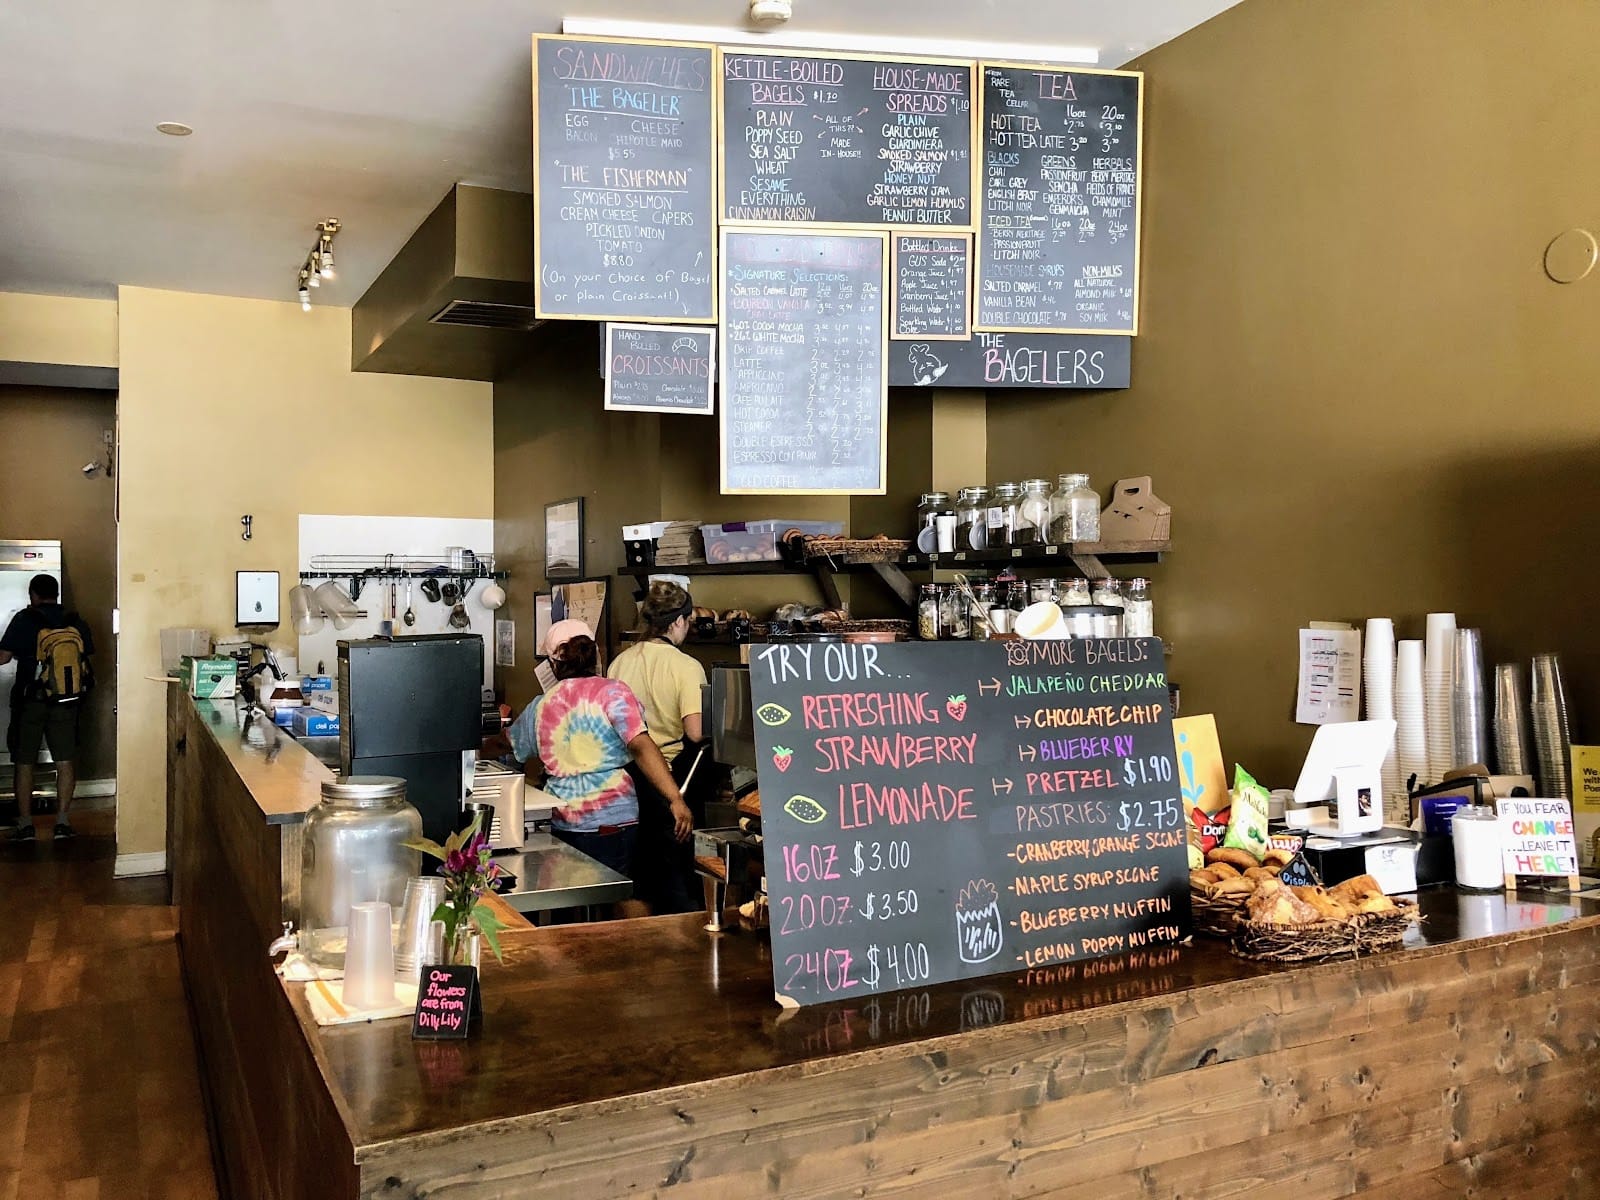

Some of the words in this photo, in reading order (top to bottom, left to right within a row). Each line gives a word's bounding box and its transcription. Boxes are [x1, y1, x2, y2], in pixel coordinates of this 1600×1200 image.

[553, 47, 706, 91] SANDWICHES
[725, 57, 844, 85] KETTLE-BOILED
[873, 66, 964, 92] HOUSE-MADE
[991, 77, 1010, 87] RARE
[751, 82, 805, 104] BAGELS
[999, 88, 1015, 98] TEA
[1032, 73, 1078, 101] TEA
[568, 87, 604, 108] THE
[612, 87, 682, 115] BAGELER
[886, 92, 947, 113] SPREADS
[566, 113, 588, 127] EGG
[756, 110, 793, 127] PLAIN
[825, 114, 839, 124] ALL
[897, 113, 927, 126] PLAIN
[991, 113, 1015, 131] HOT
[1017, 115, 1041, 132] TEA
[631, 120, 680, 135] CHEESE
[881, 124, 913, 138] GARLIC
[913, 126, 940, 139] CHIVE
[745, 126, 773, 143] POPPY
[777, 128, 803, 145] SEED
[831, 137, 851, 148] MADE
[989, 130, 1015, 146] HOT
[1015, 132, 1038, 149] TEA
[1039, 135, 1066, 149] LATTE
[749, 144, 769, 159] SEA
[774, 145, 799, 160] SALT
[877, 148, 912, 160] SMOKED
[914, 150, 948, 162] SALMON
[987, 151, 1020, 165] BLACKS
[755, 160, 789, 175] WHEAT
[887, 161, 942, 174] STRAWBERRY
[1041, 155, 1076, 168] GREENS
[1093, 157, 1133, 170] HERBALS
[884, 172, 913, 184] HONEY
[917, 173, 937, 185] NUT
[988, 166, 1006, 177] CHAI
[1040, 169, 1088, 182] PASSIONFRUIT
[1090, 171, 1108, 183] BERRY
[750, 176, 792, 192] SESAME
[873, 183, 928, 196] STRAWBERRY
[931, 185, 951, 196] JAM
[1008, 177, 1029, 189] GREY
[573, 191, 621, 206] SMOKED
[626, 194, 672, 211] SALMON
[741, 191, 806, 206] EVERYTHING
[867, 194, 898, 207] GARLIC
[901, 196, 927, 208] LEMON
[930, 197, 966, 210] HUMMUS
[987, 189, 1015, 200] ENGLISH
[1092, 196, 1133, 208] CHAMOMILE
[728, 206, 782, 220] CINNAMON
[785, 206, 816, 221] RAISIN
[1016, 201, 1033, 212] NOIR
[1102, 207, 1125, 218] MINT
[560, 207, 599, 221] CREAM
[602, 208, 638, 222] CHEESE
[652, 212, 694, 226] CAPERS
[882, 207, 914, 222] PEANUT
[917, 209, 952, 224] BUTTER
[987, 215, 1012, 227] ICED
[1014, 215, 1031, 228] TEA
[586, 222, 631, 238] PICKLED
[635, 226, 664, 240] ONION
[596, 239, 642, 252] TOMATO
[901, 238, 929, 253] Bottled
[932, 240, 959, 252] Drinks
[1022, 250, 1041, 261] NOIR
[574, 274, 600, 288] your
[656, 270, 675, 283] of
[681, 271, 710, 285] Bagel
[734, 264, 786, 281] SIGNATURE
[900, 267, 927, 280] Orange
[733, 283, 760, 297] SALTED
[901, 278, 917, 291] Apple
[983, 280, 1011, 293] SALTED
[1013, 282, 1043, 293] CARAMEL
[555, 293, 568, 302] or
[789, 288, 809, 298] LATTE
[1075, 289, 1101, 299] ALMOND
[900, 302, 923, 314] Bottled
[926, 302, 944, 314] Water
[983, 296, 1012, 308] VANILLA
[1015, 295, 1037, 308] BEAN
[1075, 302, 1105, 311] ORGANIC
[981, 311, 1010, 324] DOUBLE
[1013, 311, 1052, 325] CHOCOLATE
[752, 321, 775, 332] COCOA
[777, 323, 804, 333] MOCHA
[630, 341, 660, 351] ROLLED
[752, 332, 779, 344] WHITE
[780, 334, 805, 345] MOCHA
[975, 332, 1005, 348] THE
[612, 354, 709, 378] CROISSANTS
[733, 357, 762, 369] LATTE
[983, 348, 1105, 386] BAGELERS
[1033, 639, 1076, 666] MORE
[1085, 638, 1149, 665] BAGELS:
[757, 644, 812, 684] TRY
[1005, 672, 1085, 697] JALAPEÑO
[1090, 672, 1168, 694] CHEDDAR
[802, 692, 940, 730] REFRESHING
[1034, 706, 1120, 729] CHOCOLATE
[1120, 703, 1163, 725] CHIP
[815, 732, 978, 773] STRAWBERRY
[1039, 734, 1134, 762] BLUEBERRY
[1026, 768, 1119, 795] PRETZEL
[1123, 755, 1172, 788] $1.90
[1583, 767, 1598, 776] We
[839, 782, 977, 830] LEMONADE
[1500, 803, 1511, 815] IF
[1514, 802, 1533, 815] YOU
[1535, 802, 1569, 815] FEAR
[1116, 798, 1178, 832] $2.75
[1512, 820, 1574, 835] CHANGE
[1092, 833, 1141, 857] ORANGE
[1145, 828, 1185, 850] SCONE
[1555, 840, 1570, 851] IT
[850, 840, 911, 878] $3.00
[1073, 869, 1113, 891] SYRUP
[1115, 865, 1160, 886] SCONE
[859, 889, 919, 921] $3.50
[1114, 895, 1171, 919] MUFFIN
[1081, 933, 1124, 954] POPPY
[1128, 925, 1180, 949] MUFFIN
[861, 942, 930, 990] $4.00
[430, 970, 452, 982] Our
[427, 982, 466, 997] flowers
[421, 998, 439, 1010] are
[440, 997, 463, 1011] from
[419, 1011, 440, 1032] Dilly
[440, 1012, 461, 1031] Lily
